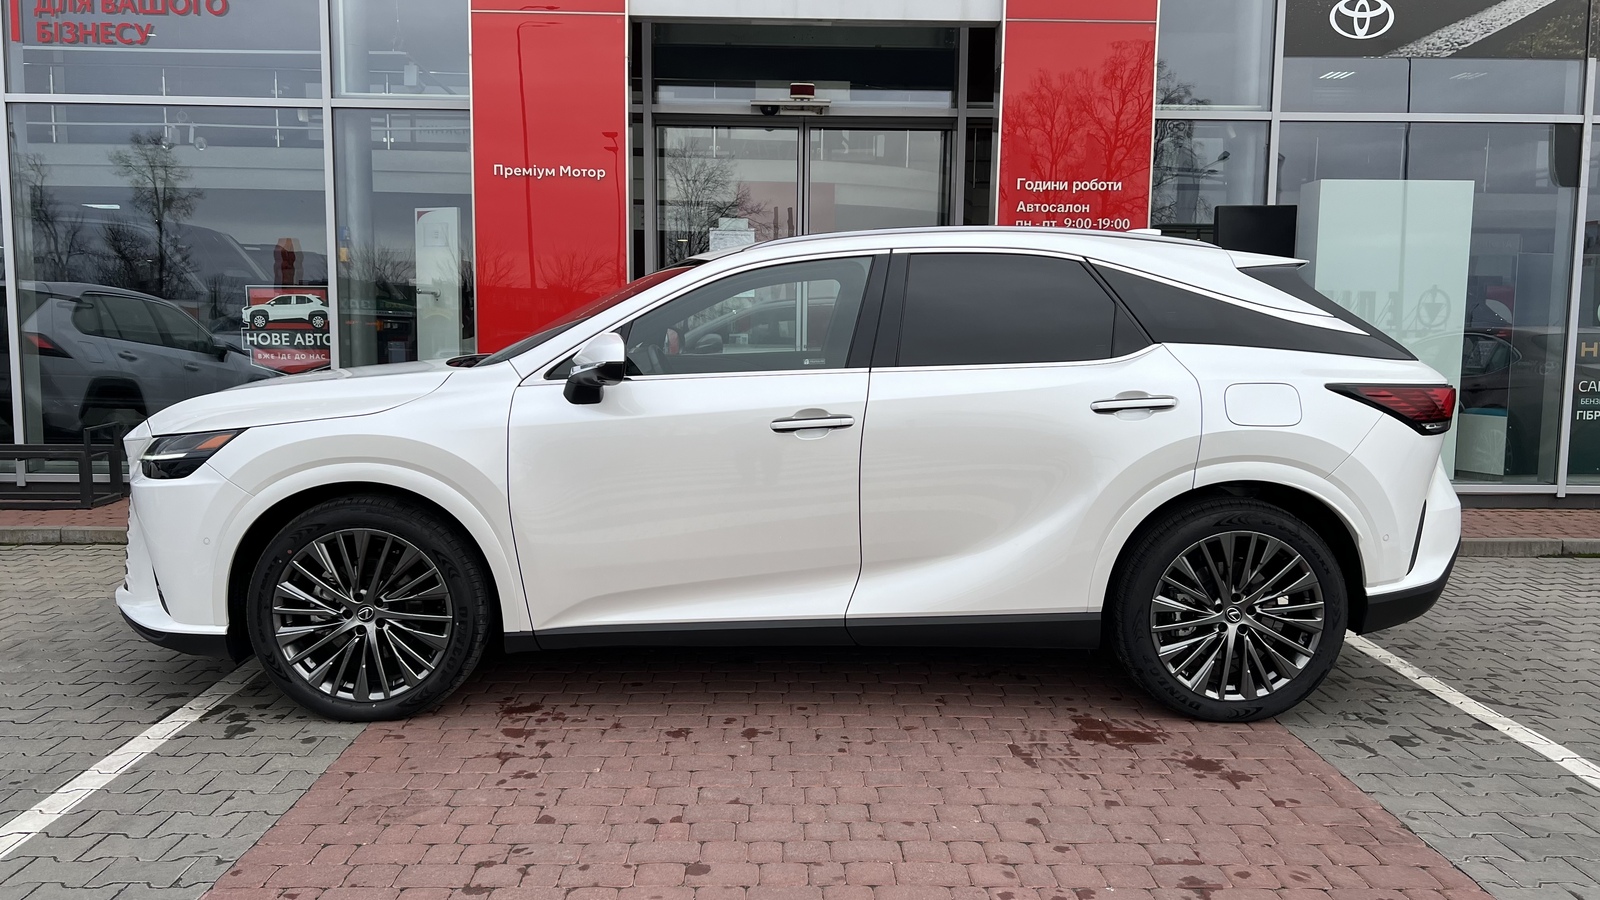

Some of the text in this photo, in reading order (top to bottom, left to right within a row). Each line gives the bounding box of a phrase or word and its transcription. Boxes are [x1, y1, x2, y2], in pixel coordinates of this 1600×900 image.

[36, 21, 152, 45] БІЗНЕСУ
[493, 164, 606, 180] Преміум Мотор
[1016, 178, 1122, 193] Години роботи
[1016, 201, 1090, 213] Автосалон
[246, 333, 290, 346] НОВЕ
[294, 353, 307, 361] ДО
